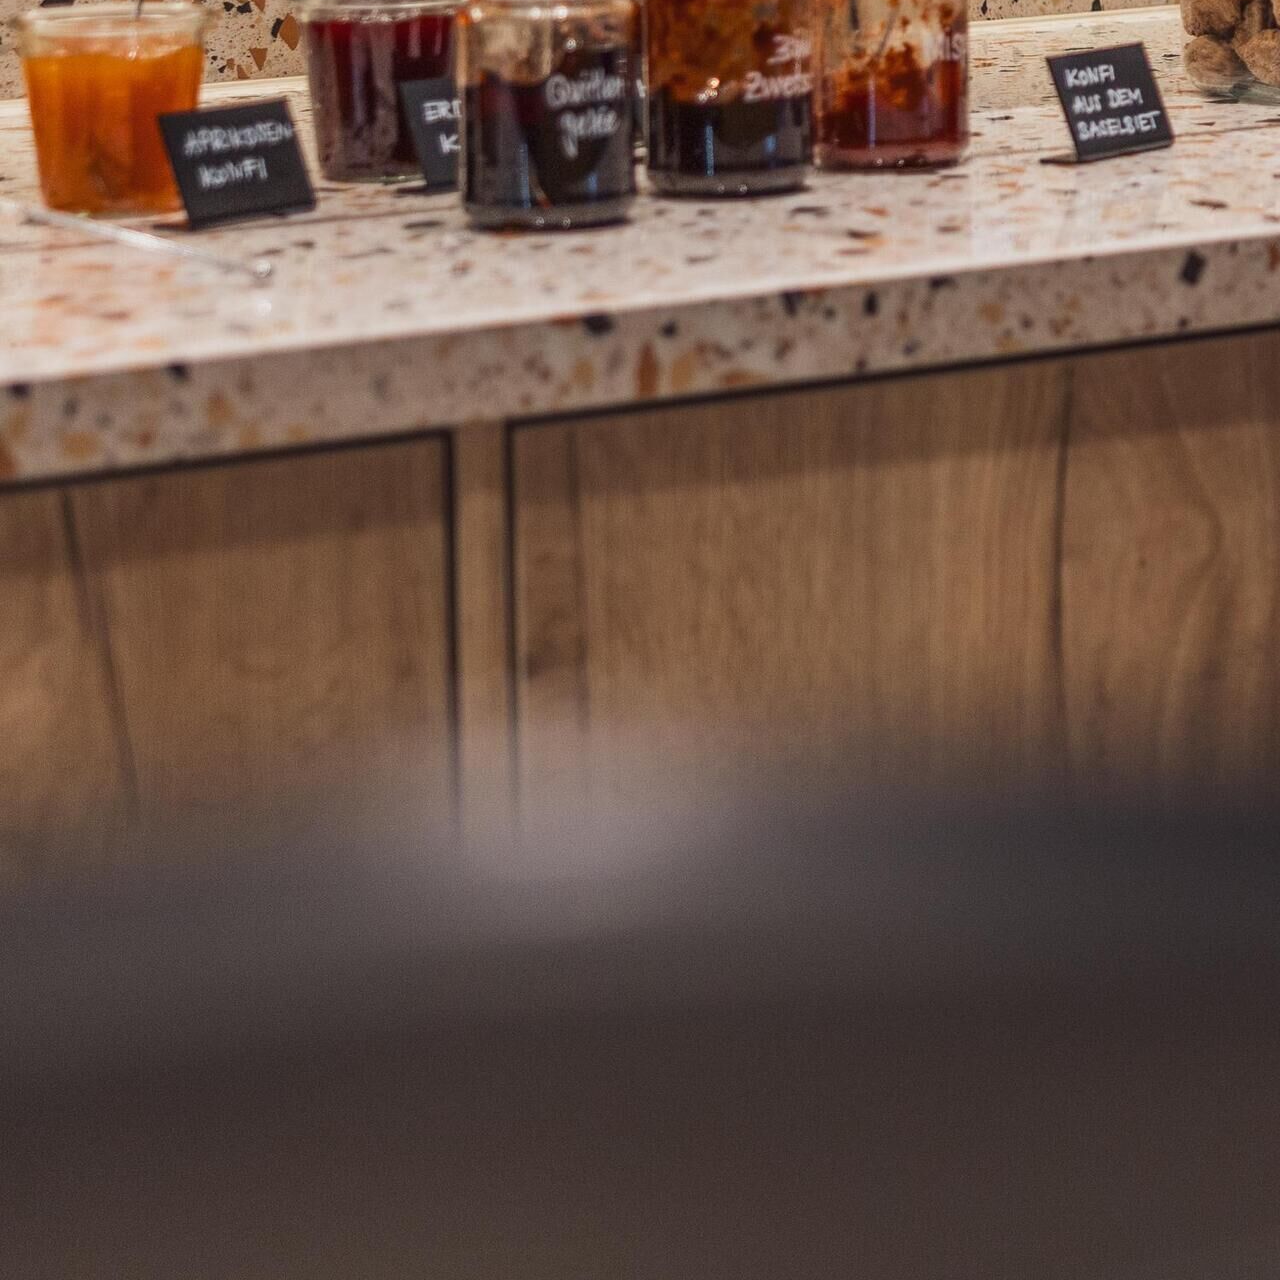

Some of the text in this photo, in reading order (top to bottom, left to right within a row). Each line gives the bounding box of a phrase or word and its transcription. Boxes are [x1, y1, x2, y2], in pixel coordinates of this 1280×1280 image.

[1064, 64, 1115, 88] KONFI
[1073, 87, 1144, 114] AUS DEM
